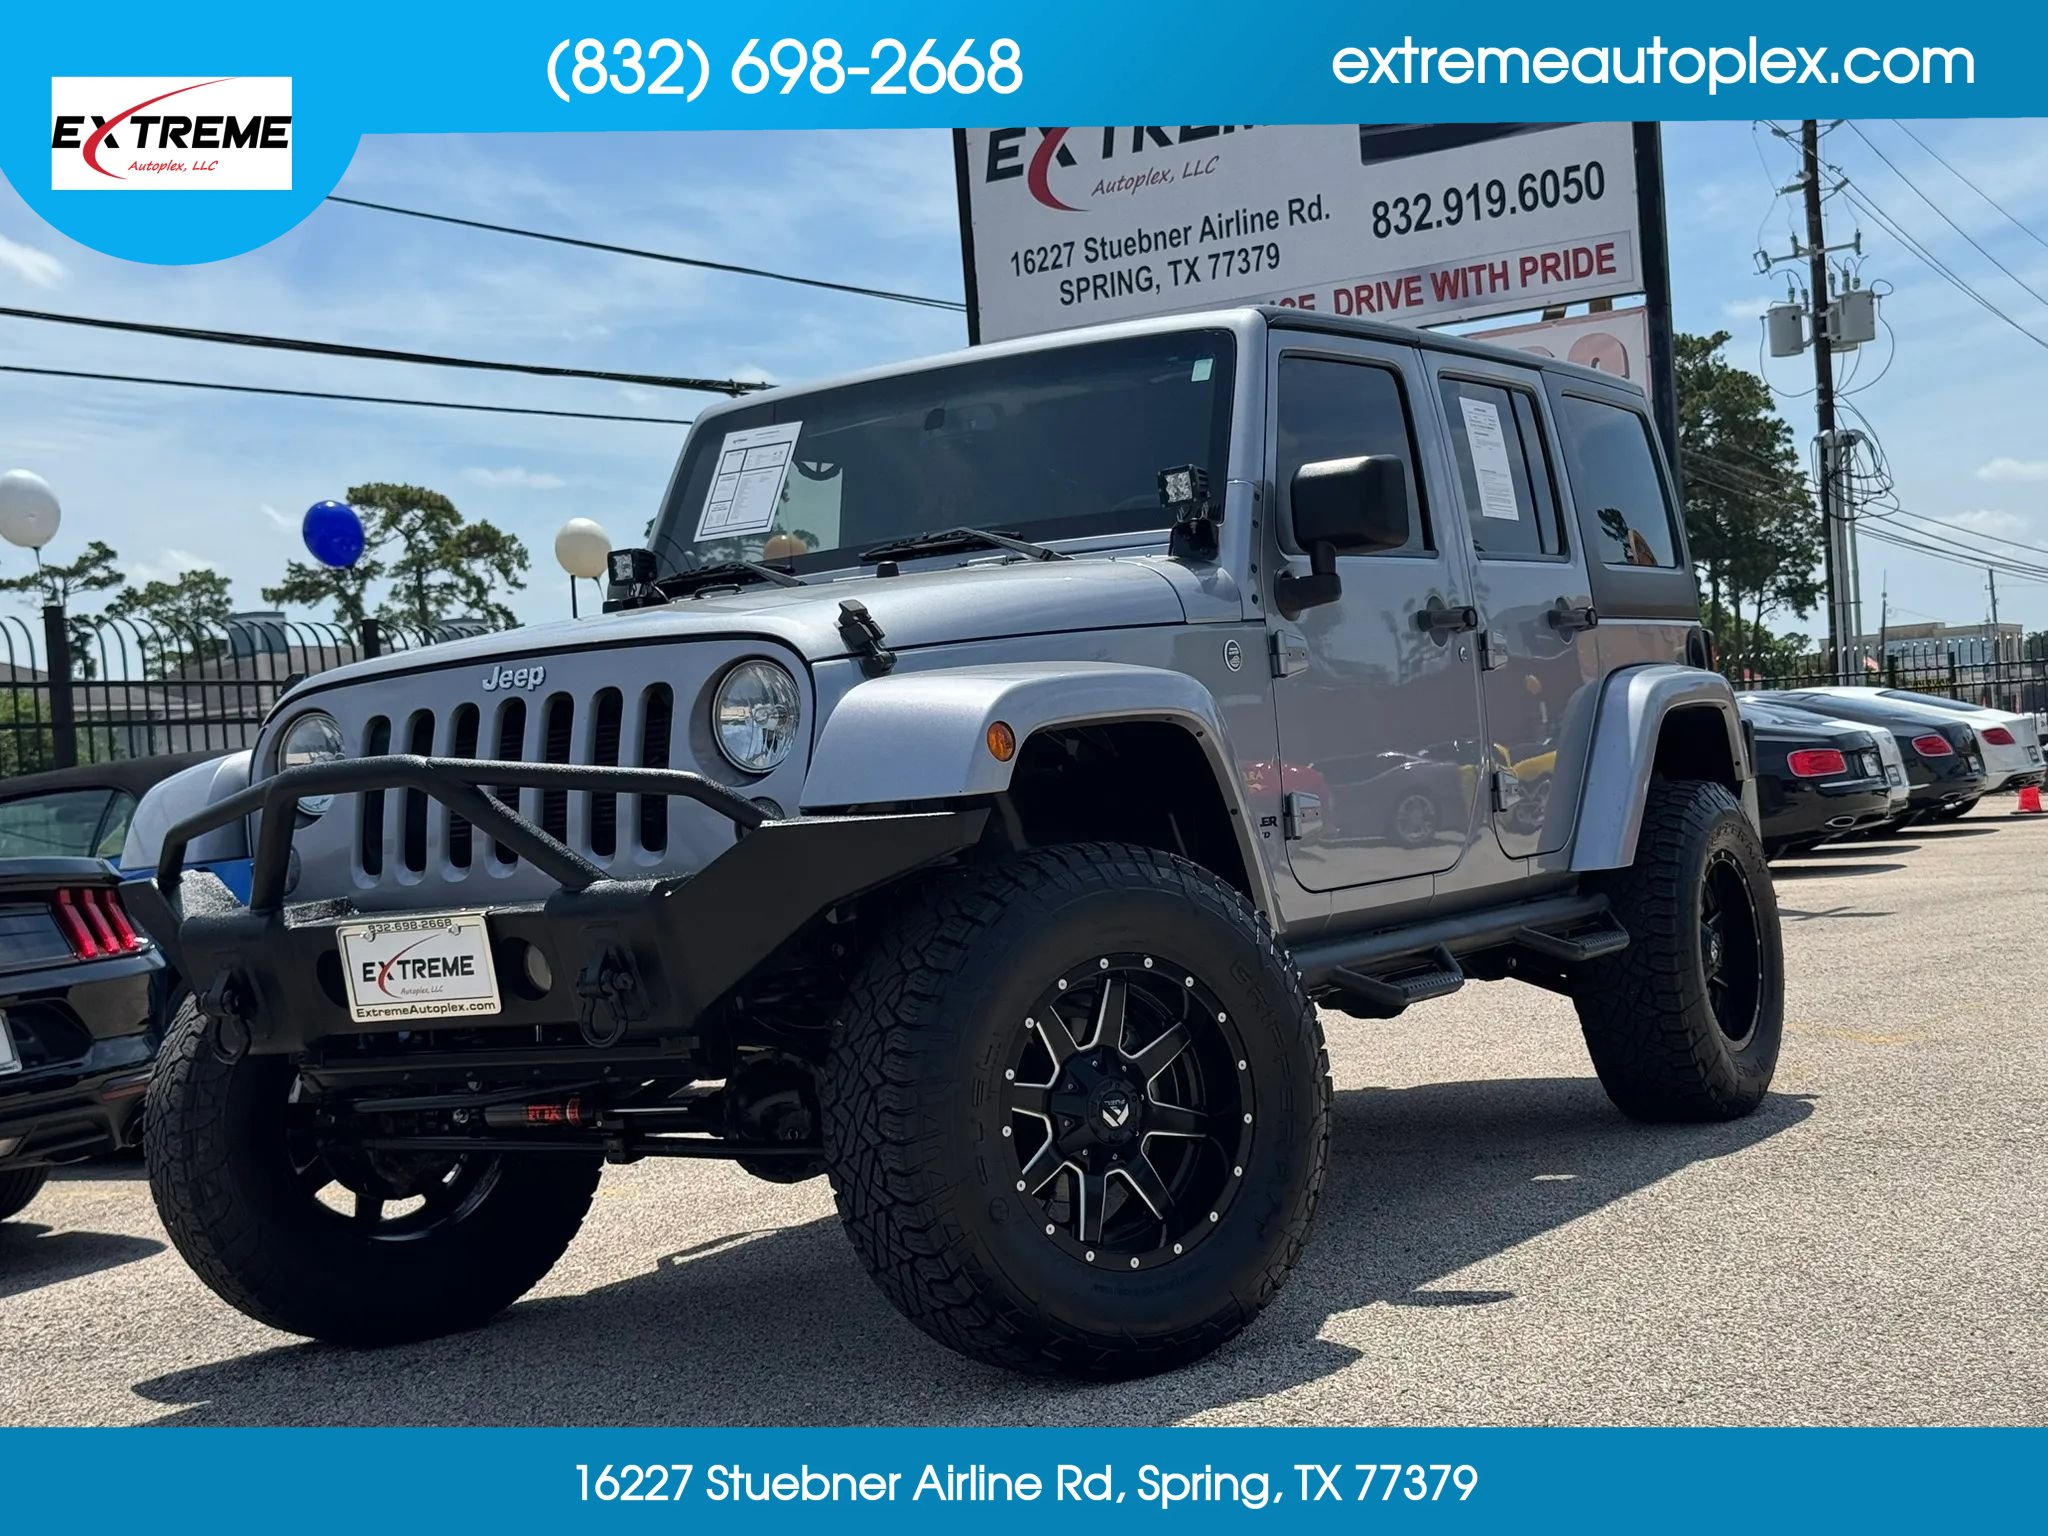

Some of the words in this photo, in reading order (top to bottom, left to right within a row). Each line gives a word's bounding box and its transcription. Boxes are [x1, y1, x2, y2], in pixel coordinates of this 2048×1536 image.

[1091, 165, 1175, 197] Autoplex,
[1182, 155, 1219, 179] LLC
[1371, 160, 1605, 239] 832.919.6050
[1010, 241, 1075, 277] 16227
[1083, 224, 1192, 265] Stuebner
[1199, 208, 1279, 243] Airline
[1287, 193, 1331, 227] Rd.
[1059, 265, 1161, 307] SPRING,
[1167, 256, 1202, 287] TX
[1207, 242, 1281, 281] 77379
[1333, 275, 1424, 318] DRIVE
[1430, 260, 1510, 302] WITH
[1519, 242, 1617, 289] PRIDE
[482, 665, 546, 691] Jeep
[362, 954, 475, 983] EXTREME
[356, 1001, 496, 1018] ExtremeAutoplex.com
